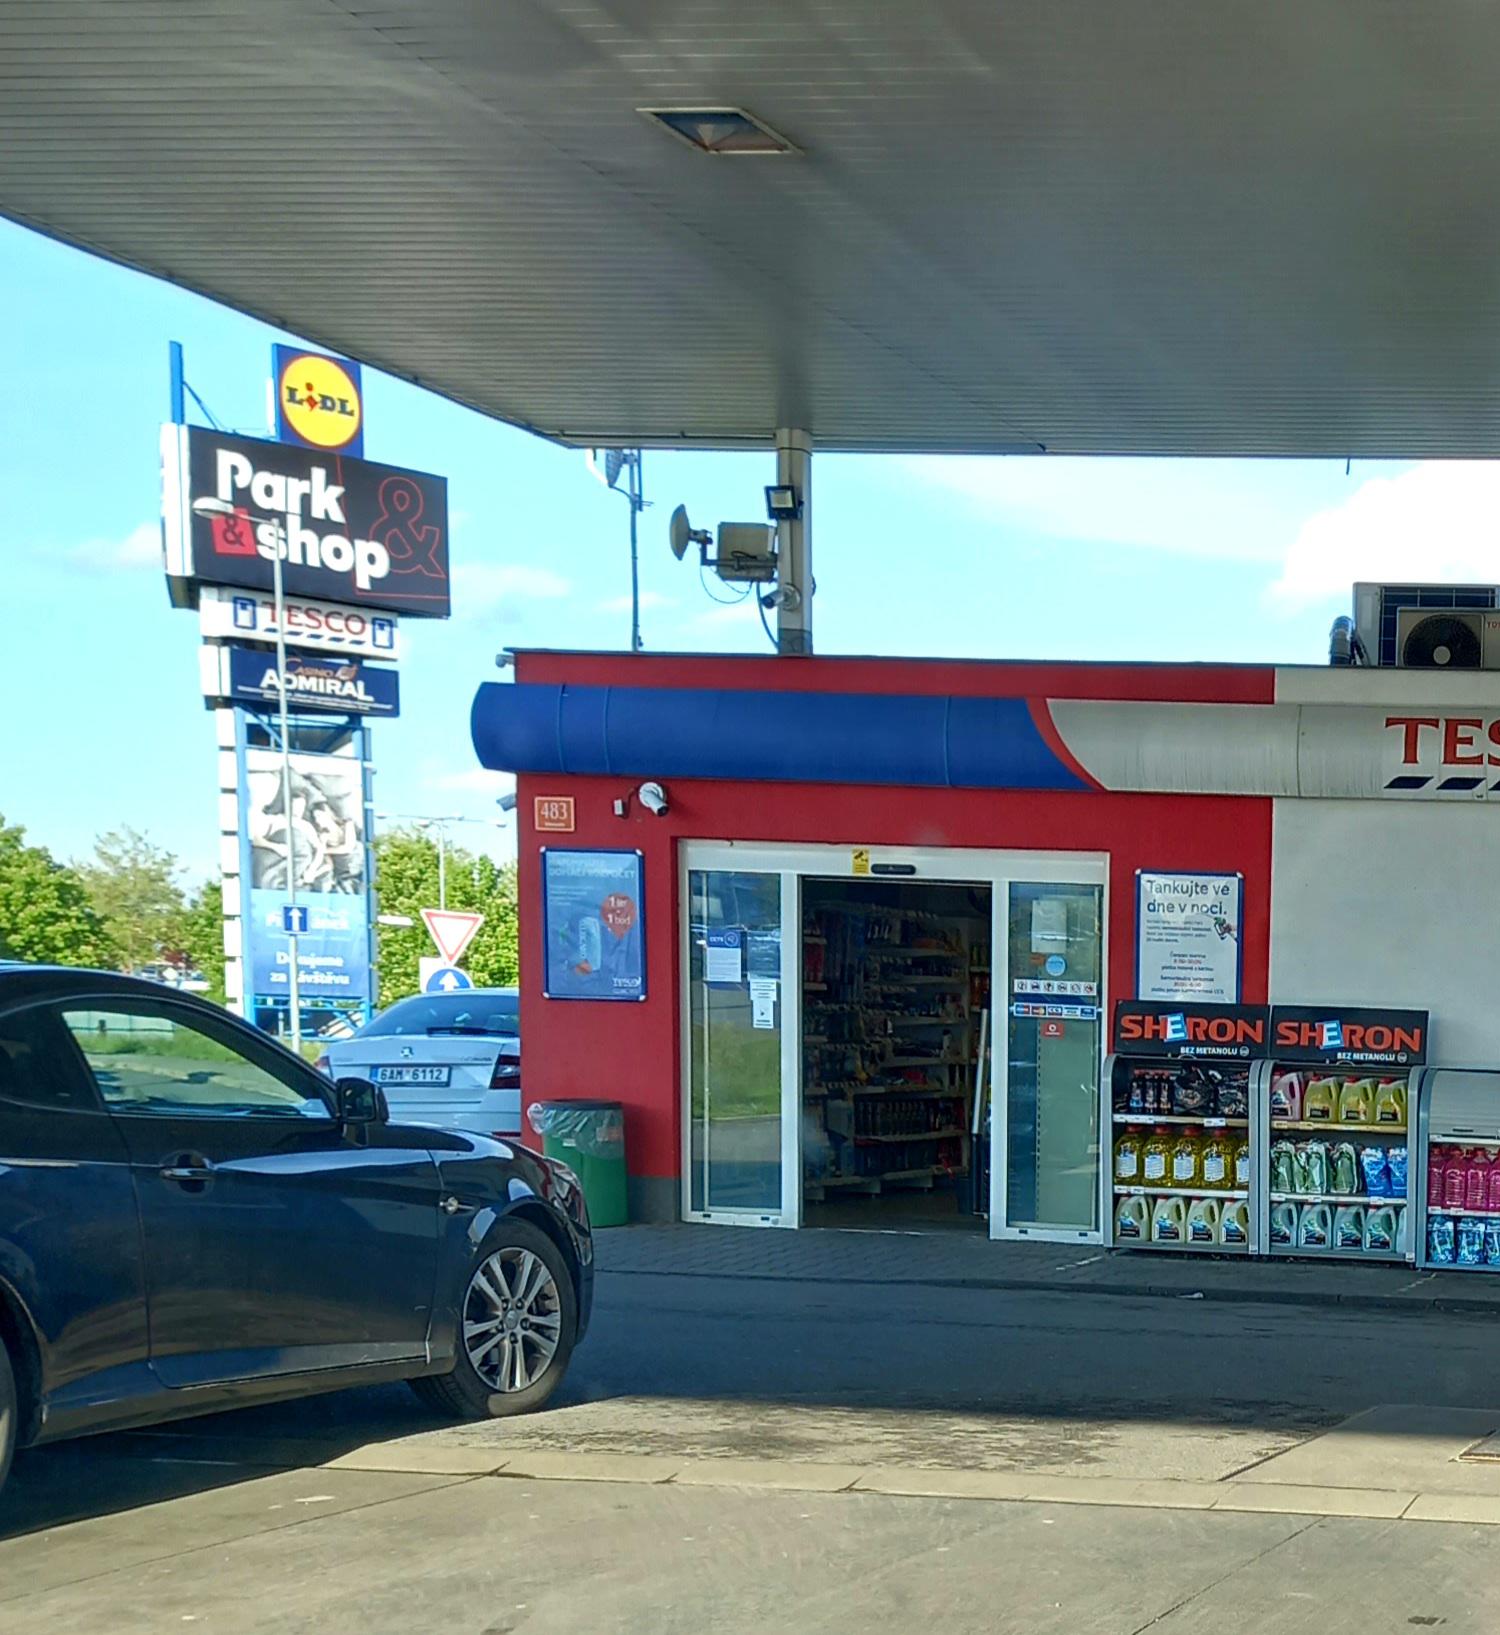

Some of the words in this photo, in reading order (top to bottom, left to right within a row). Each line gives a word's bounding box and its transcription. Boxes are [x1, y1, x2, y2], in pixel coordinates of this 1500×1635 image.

[216, 448, 346, 523] Park
[256, 514, 390, 590] shop
[262, 601, 366, 635] TESCO
[260, 668, 374, 702] ADMIRAL
[541, 802, 568, 820] 483
[1146, 879, 1209, 898] Tankujte
[1147, 899, 1175, 914] dne
[1179, 903, 1187, 914] v
[1191, 901, 1228, 915] noci.
[1120, 1012, 1264, 1043] SHERON
[1276, 1019, 1421, 1051] SHERON
[1180, 1047, 1195, 1055] BEZ
[1196, 1047, 1238, 1056] METANOLU
[1337, 1052, 1351, 1061] BEZ
[1352, 1053, 1395, 1062] METANOLU
[380, 1069, 403, 1080] 6AM
[412, 1069, 442, 1080] 6112
